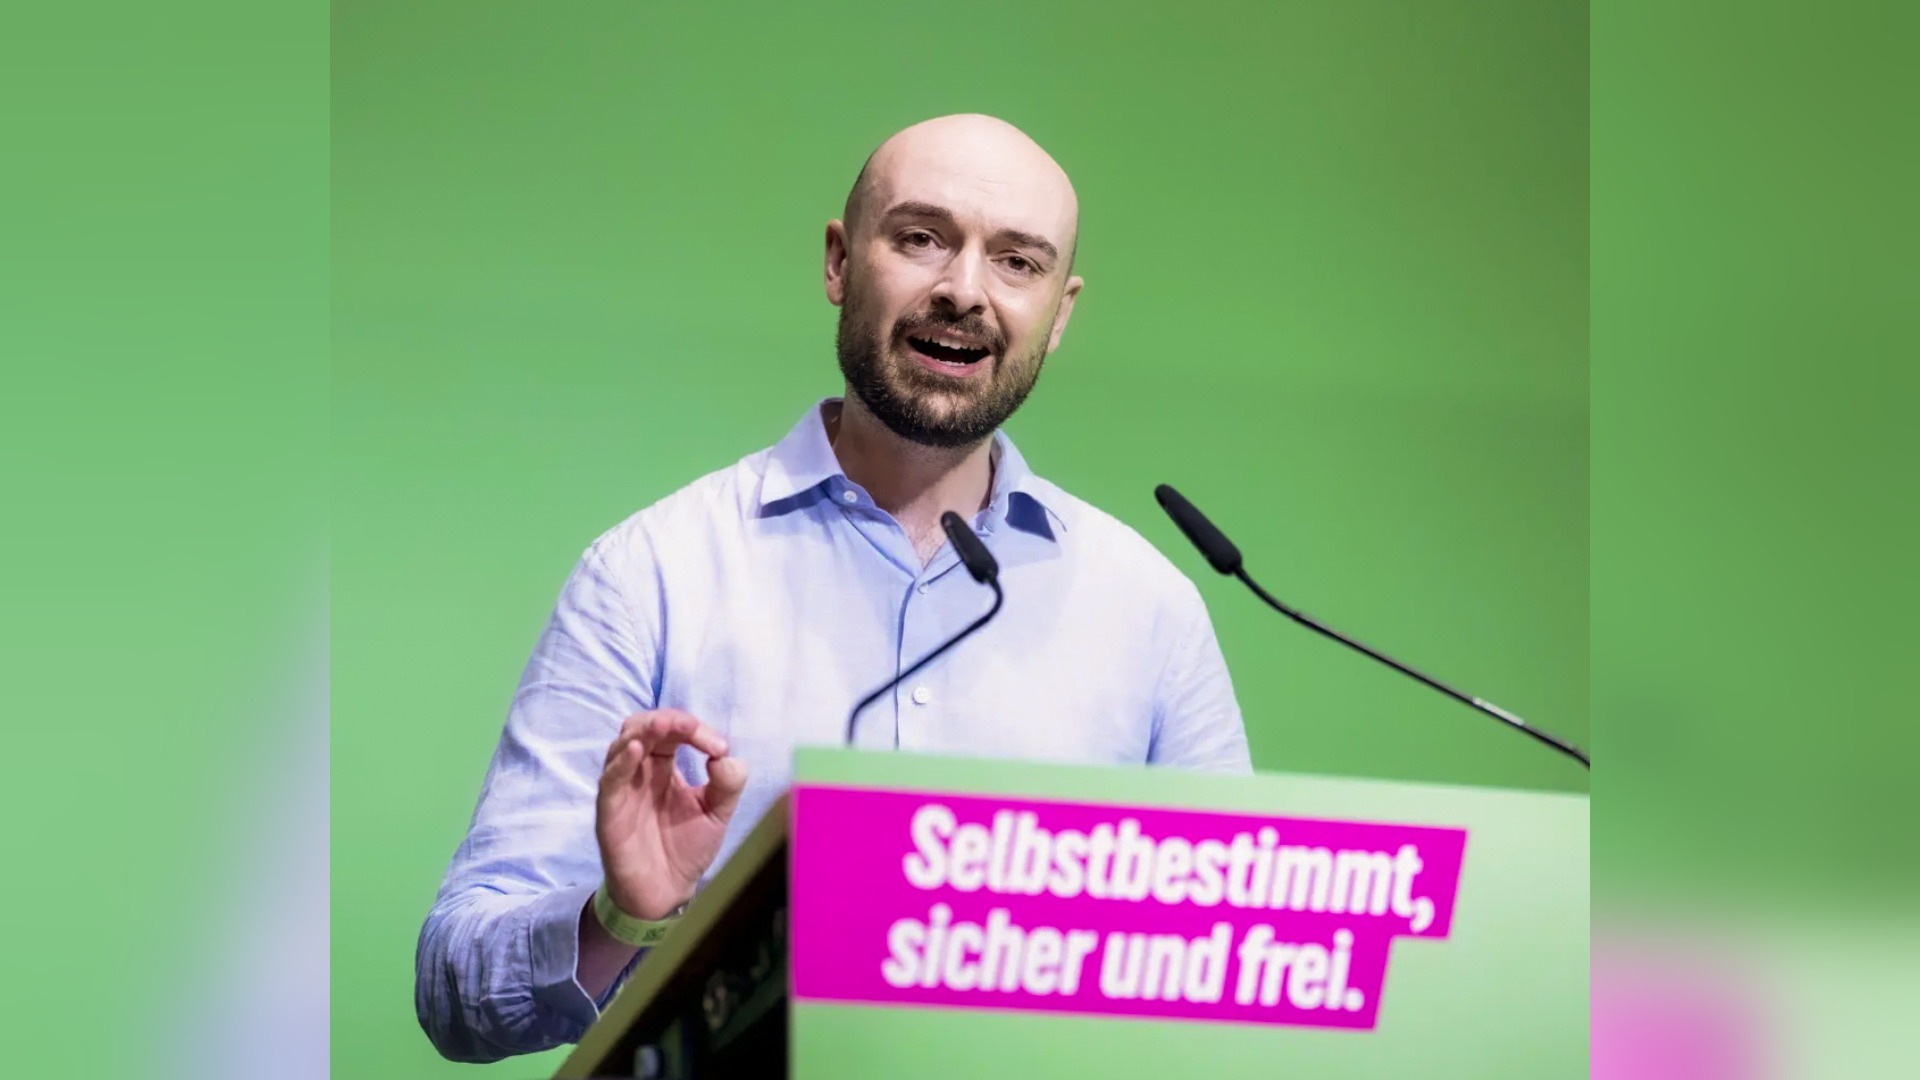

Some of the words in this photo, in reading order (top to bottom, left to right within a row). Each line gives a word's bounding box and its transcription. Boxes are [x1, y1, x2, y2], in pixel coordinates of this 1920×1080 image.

[903, 804, 1435, 932] Selbstbestimmt,
[882, 904, 1098, 995] sicher
[1100, 922, 1233, 1003] und
[1235, 924, 1364, 1011] frei.
